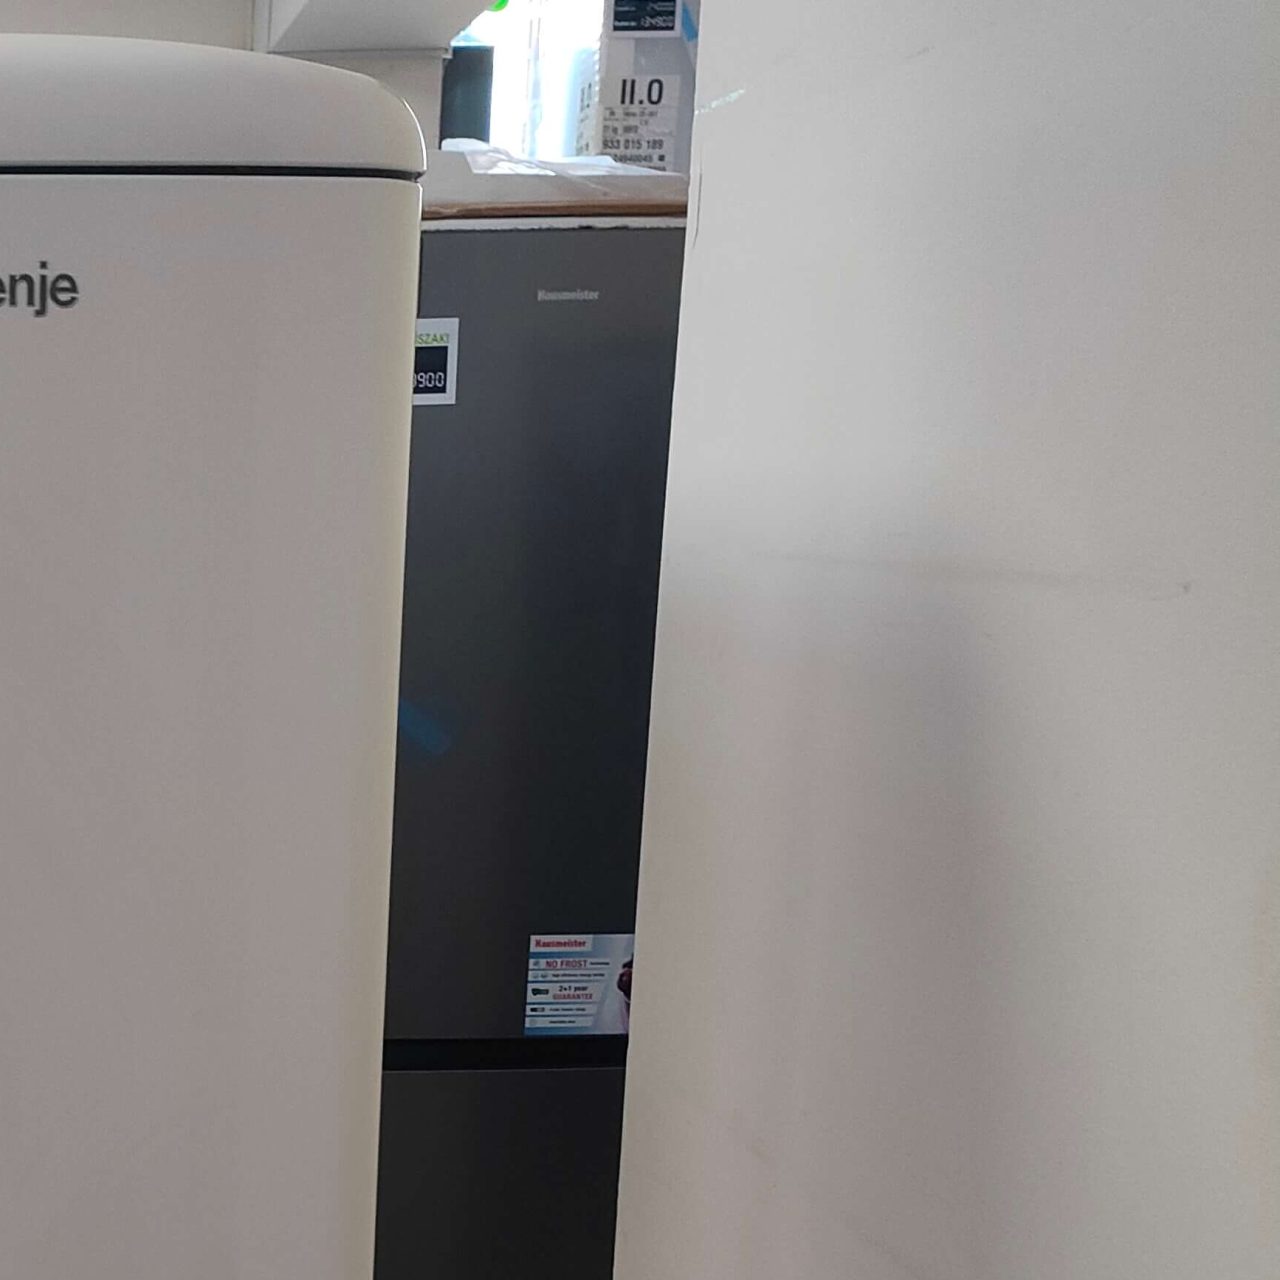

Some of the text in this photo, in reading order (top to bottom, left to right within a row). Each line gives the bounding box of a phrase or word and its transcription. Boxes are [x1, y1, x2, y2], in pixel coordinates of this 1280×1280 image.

[535, 939, 586, 948] Hausmeister
[545, 960, 558, 969] NO
[560, 959, 588, 968] FROST
